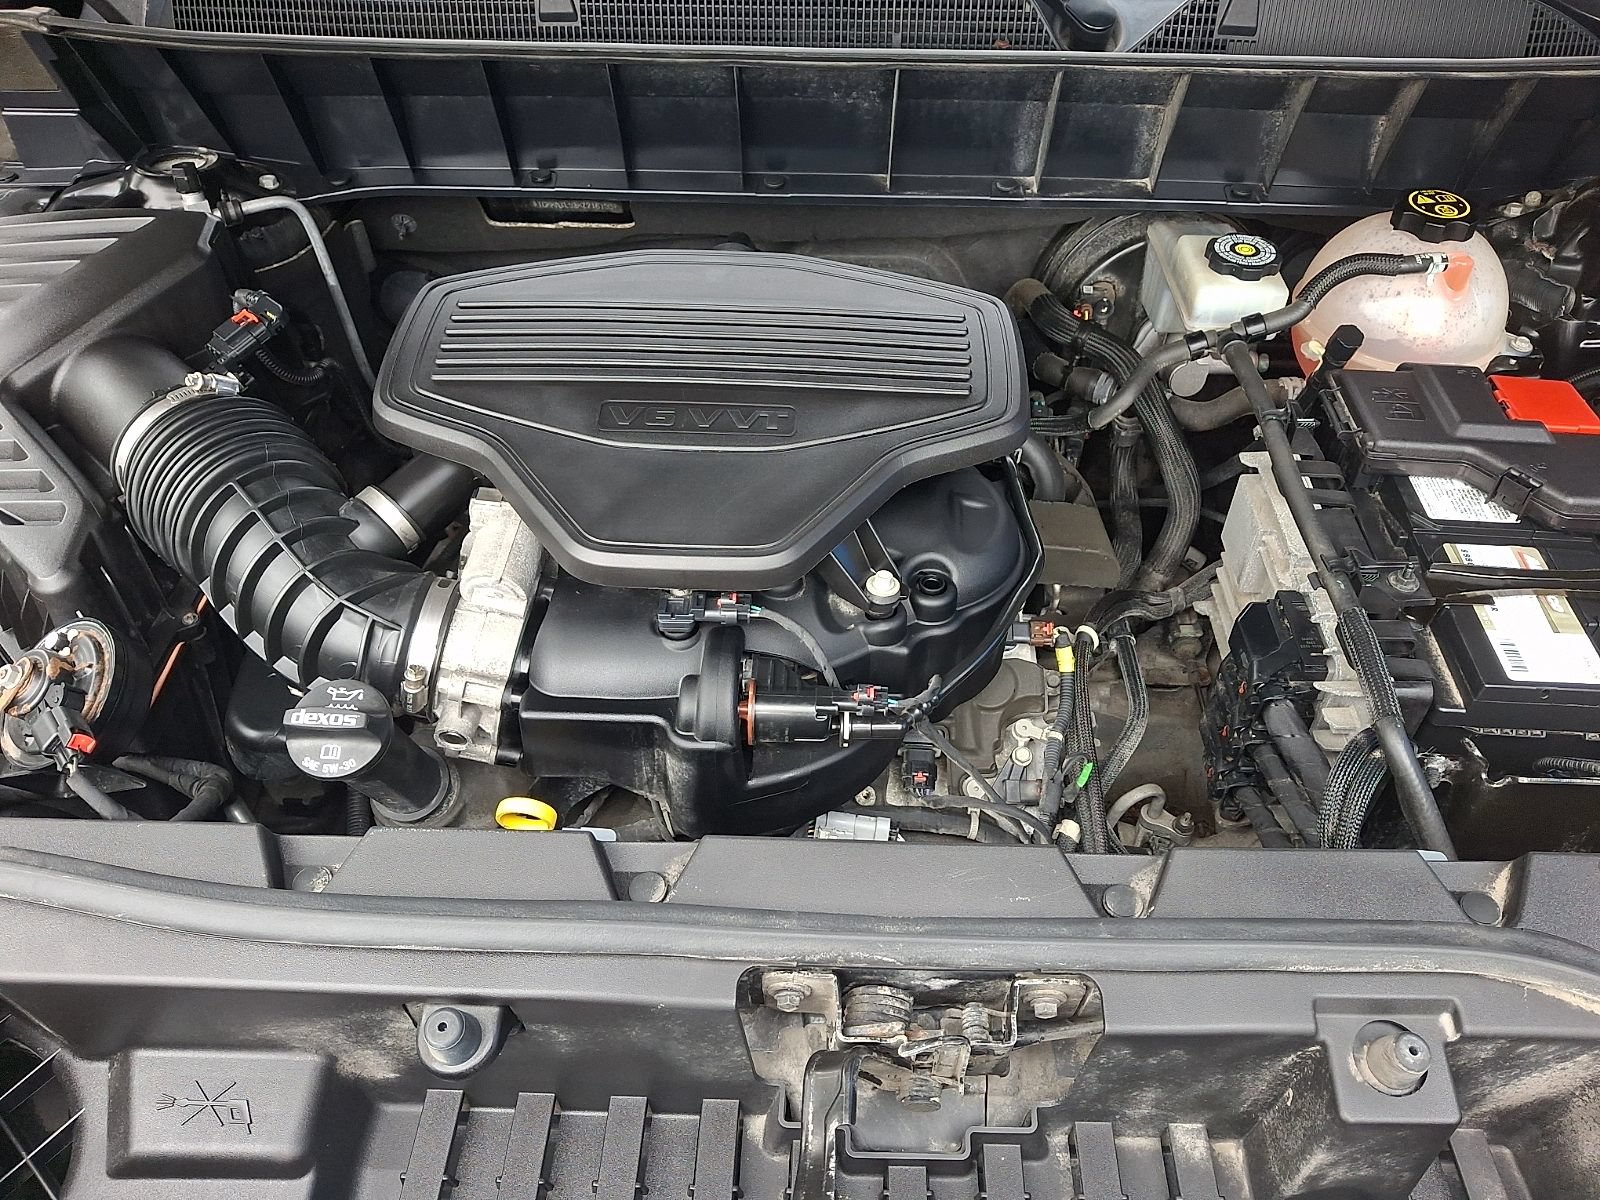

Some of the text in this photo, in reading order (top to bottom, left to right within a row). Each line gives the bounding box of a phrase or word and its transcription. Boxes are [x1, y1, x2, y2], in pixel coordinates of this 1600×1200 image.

[608, 405, 789, 430] V6 VVT
[290, 708, 358, 727] dexos
[301, 756, 356, 774] SAE 5W-30
